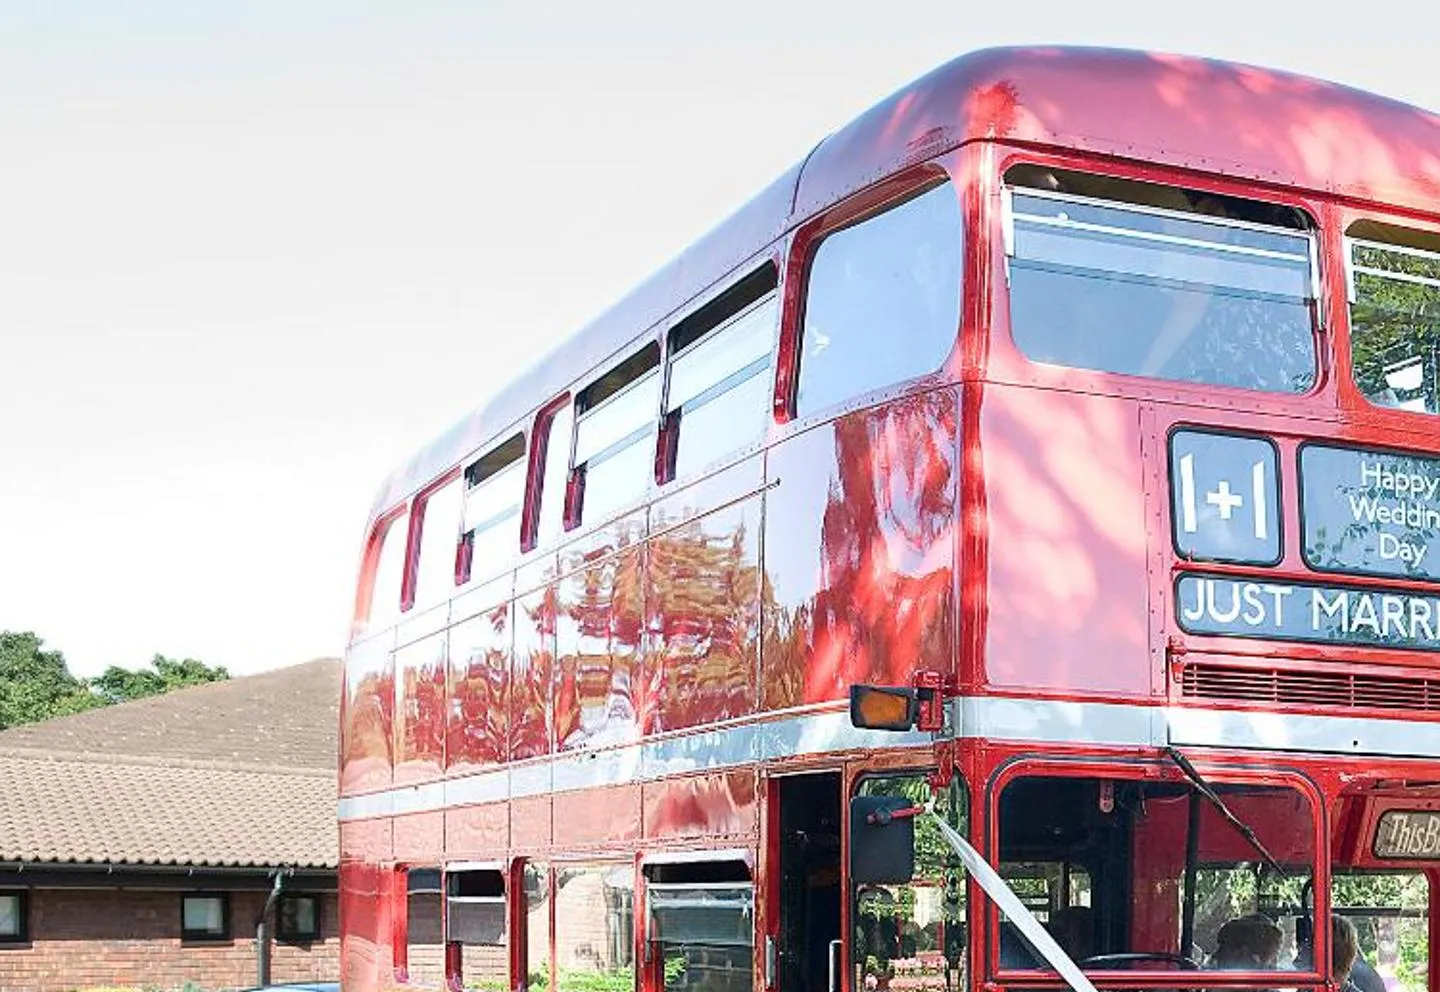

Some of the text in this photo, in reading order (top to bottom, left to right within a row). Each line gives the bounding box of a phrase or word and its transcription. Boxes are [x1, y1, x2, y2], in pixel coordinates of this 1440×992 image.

[1360, 460, 1440, 499] Happy
[1379, 533, 1428, 567] Day
[1184, 578, 1292, 627] JUST
